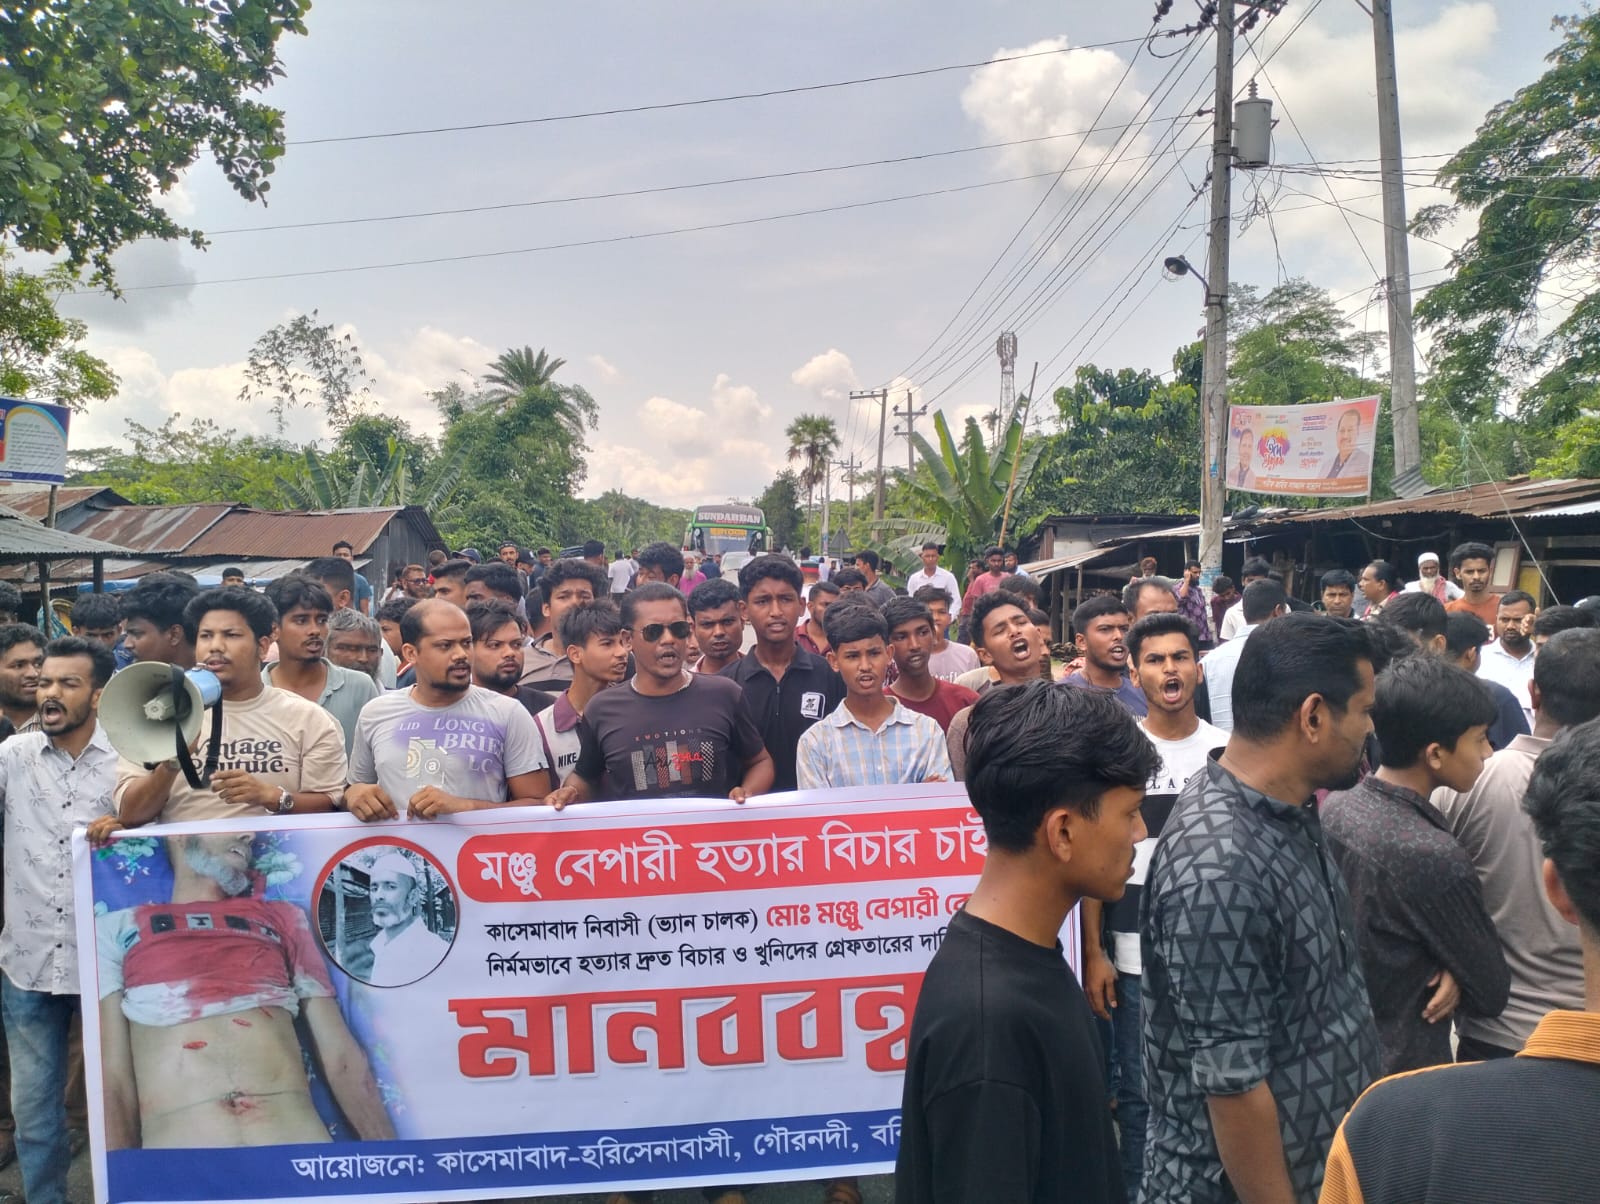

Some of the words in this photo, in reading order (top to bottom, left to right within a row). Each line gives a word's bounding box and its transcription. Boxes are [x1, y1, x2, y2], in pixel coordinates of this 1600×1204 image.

[698, 512, 760, 524] SUNDARBAN
[433, 718, 485, 733] LONG
[558, 752, 577, 768] NIKE
[473, 851, 542, 899] মঞ্জু
[555, 829, 682, 887] বেপারী
[690, 832, 809, 884] হত্যার
[817, 820, 921, 872] বিচার
[929, 811, 988, 863] চাই
[484, 920, 579, 942] কাসেমাবাদ
[583, 911, 642, 939] নিবাসী
[648, 913, 698, 939] (ভ্যান
[702, 908, 758, 933] চালক)
[816, 900, 864, 932] মঞ্জু
[865, 887, 939, 920] বেপারী
[486, 951, 572, 977] নির্মমভাবে
[577, 952, 632, 975] হত্যার
[636, 950, 673, 972] দ্রুত
[678, 944, 726, 967] বিচার
[732, 948, 748, 963] ও
[753, 938, 818, 967] খুনিদের
[825, 934, 914, 958] গ্রেফতারের
[433, 1127, 741, 1175] কাসেমাবাদ-হরিসেনাবাসী,
[753, 1119, 859, 1156] গৌরনদী,
